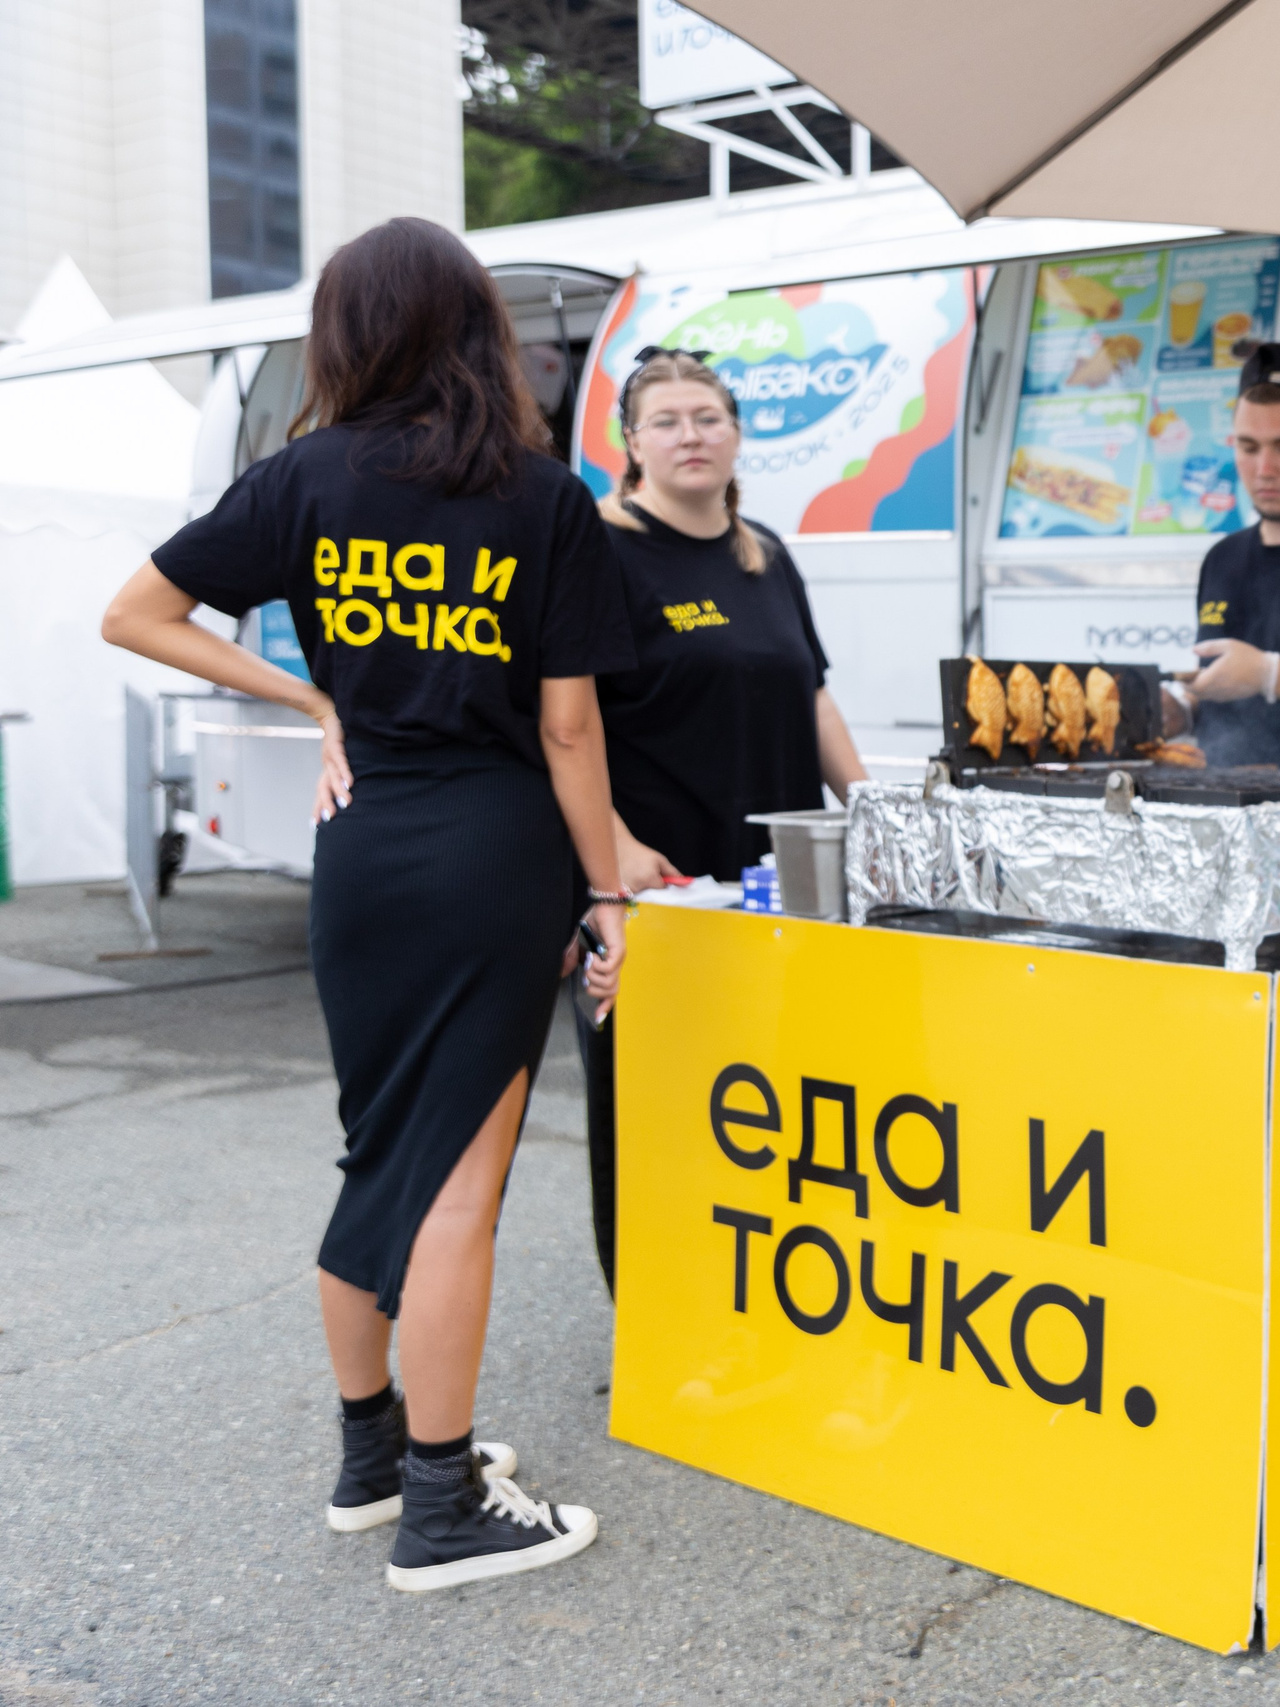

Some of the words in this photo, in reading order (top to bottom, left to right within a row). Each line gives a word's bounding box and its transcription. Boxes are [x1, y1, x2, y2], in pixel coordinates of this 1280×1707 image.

[720, 357, 872, 402] ыбака
[850, 355, 911, 430] 2025
[313, 536, 446, 598] еда
[472, 546, 518, 602] и
[314, 597, 512, 662] точка.
[709, 1062, 960, 1220] еда
[1028, 1116, 1107, 1247] и
[712, 1202, 1158, 1429] точка.
